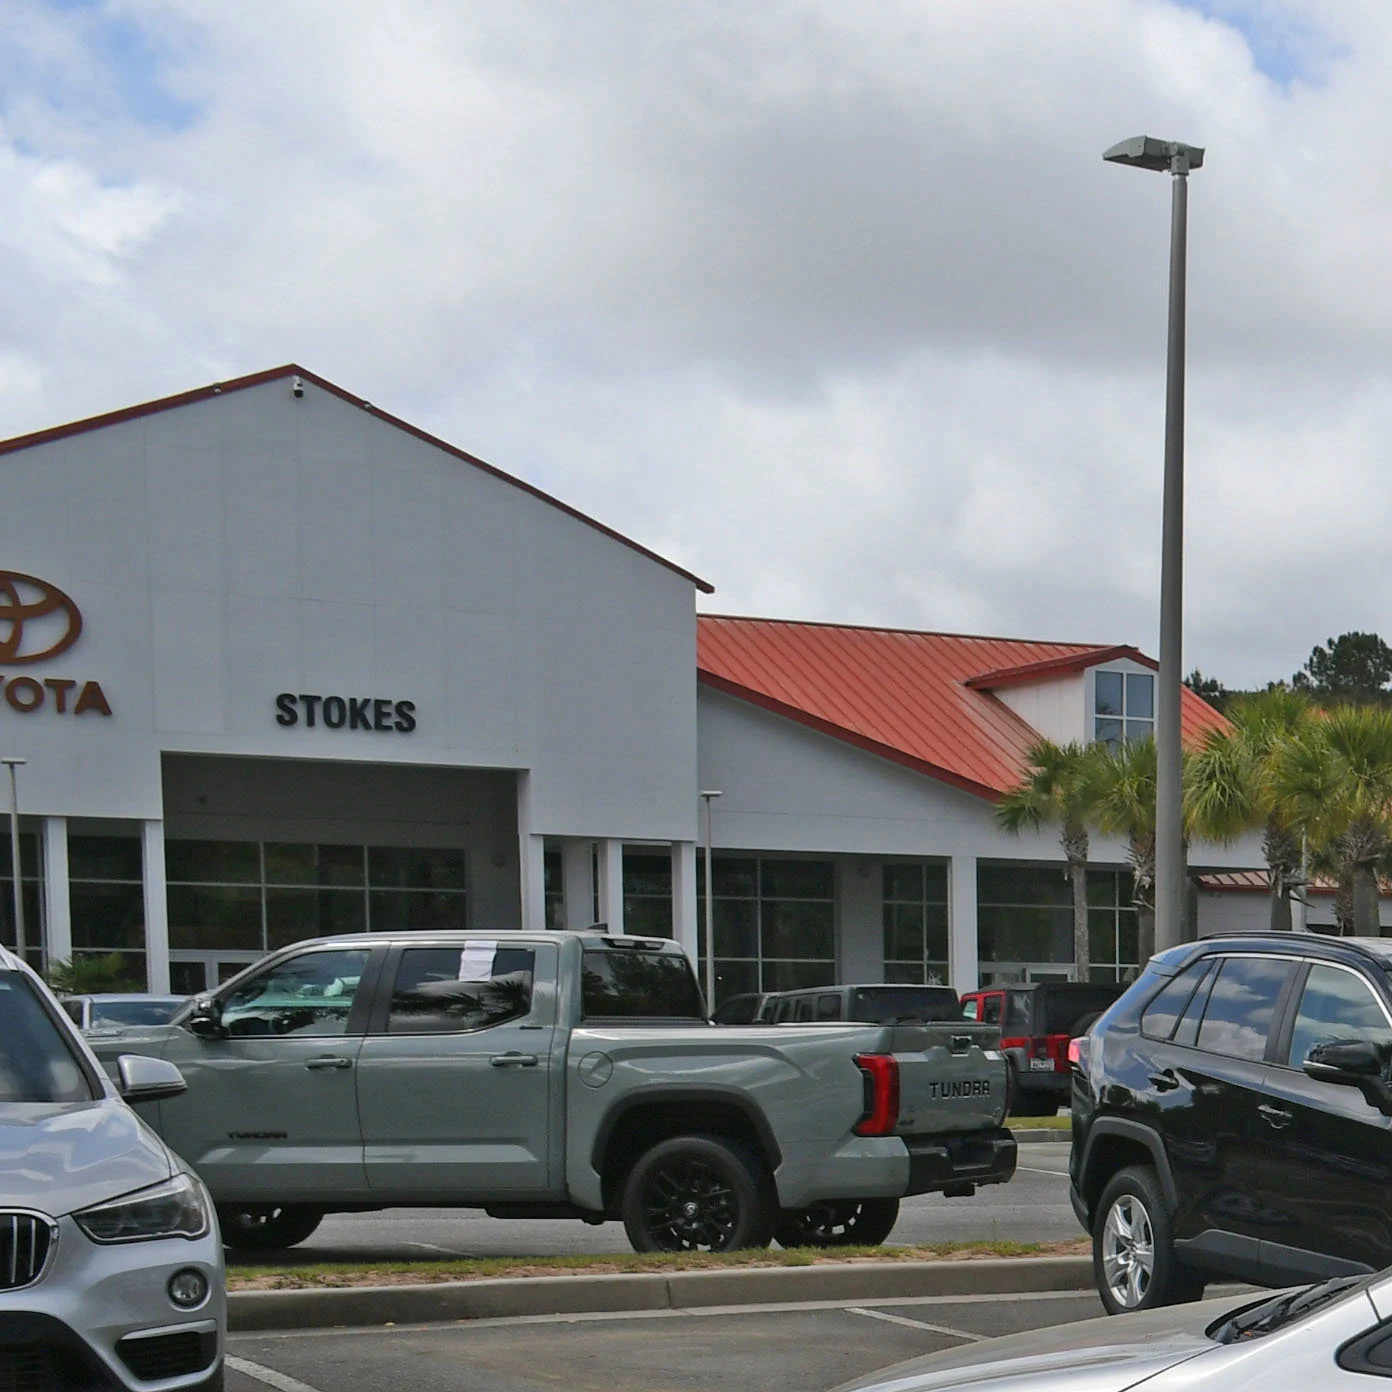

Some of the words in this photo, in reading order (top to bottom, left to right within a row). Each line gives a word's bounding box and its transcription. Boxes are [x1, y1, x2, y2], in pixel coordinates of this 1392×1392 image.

[0, 676, 112, 716] OTA
[276, 693, 416, 732] STOKES
[929, 1080, 990, 1098] TUNDRA
